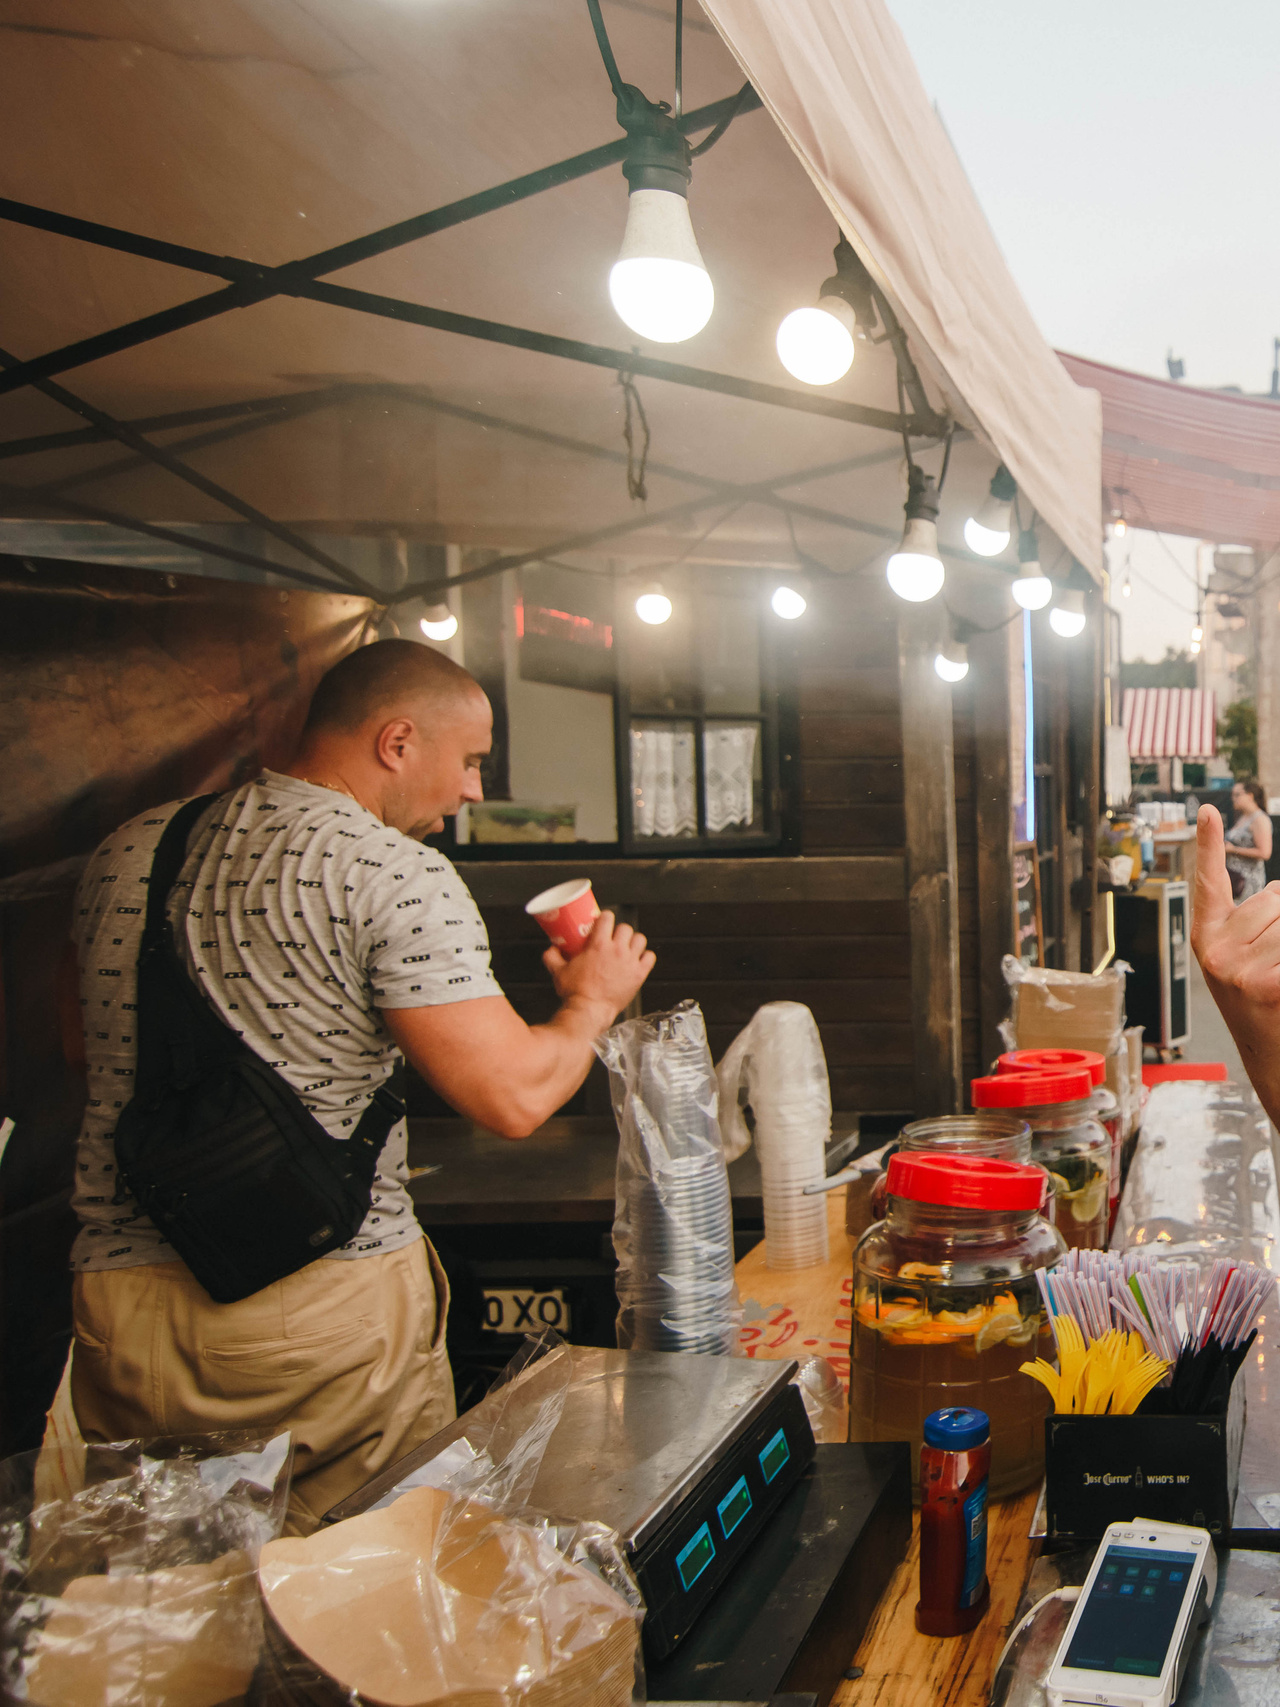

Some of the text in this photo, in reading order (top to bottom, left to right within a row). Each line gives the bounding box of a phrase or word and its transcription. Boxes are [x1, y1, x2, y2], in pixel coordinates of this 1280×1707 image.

[1102, 1472, 1130, 1486] Cuervo
[1147, 1475, 1190, 1484] WHO'S IN?
